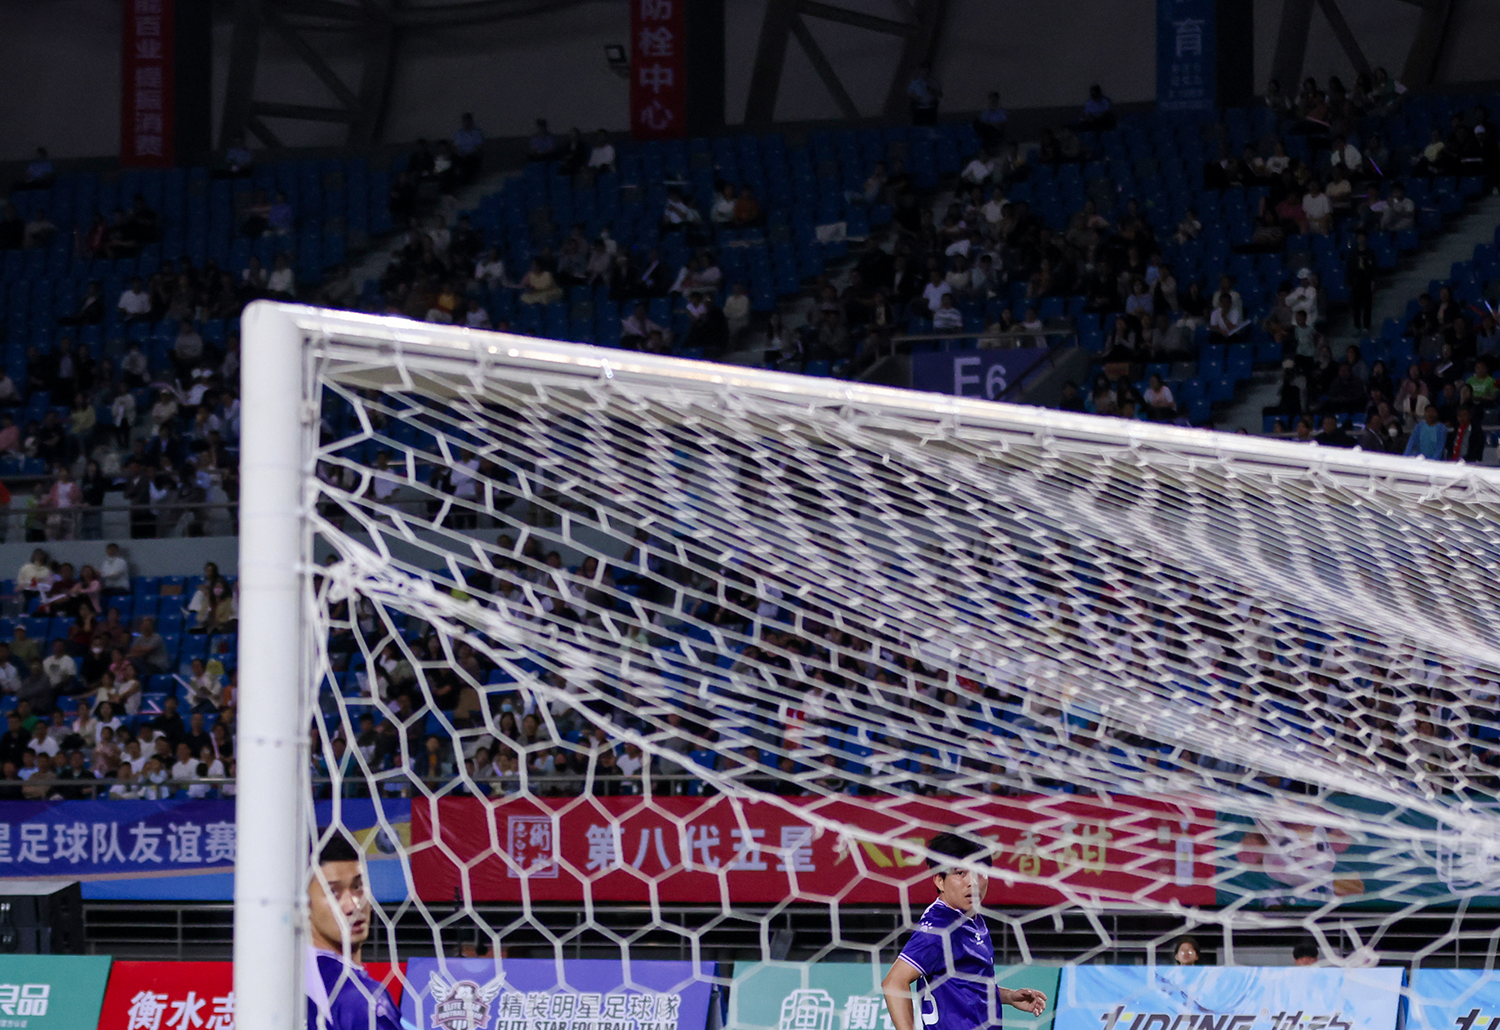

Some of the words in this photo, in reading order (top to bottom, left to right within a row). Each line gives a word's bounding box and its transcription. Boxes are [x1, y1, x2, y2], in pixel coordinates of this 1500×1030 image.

[585, 823, 817, 873] 第八代五星
